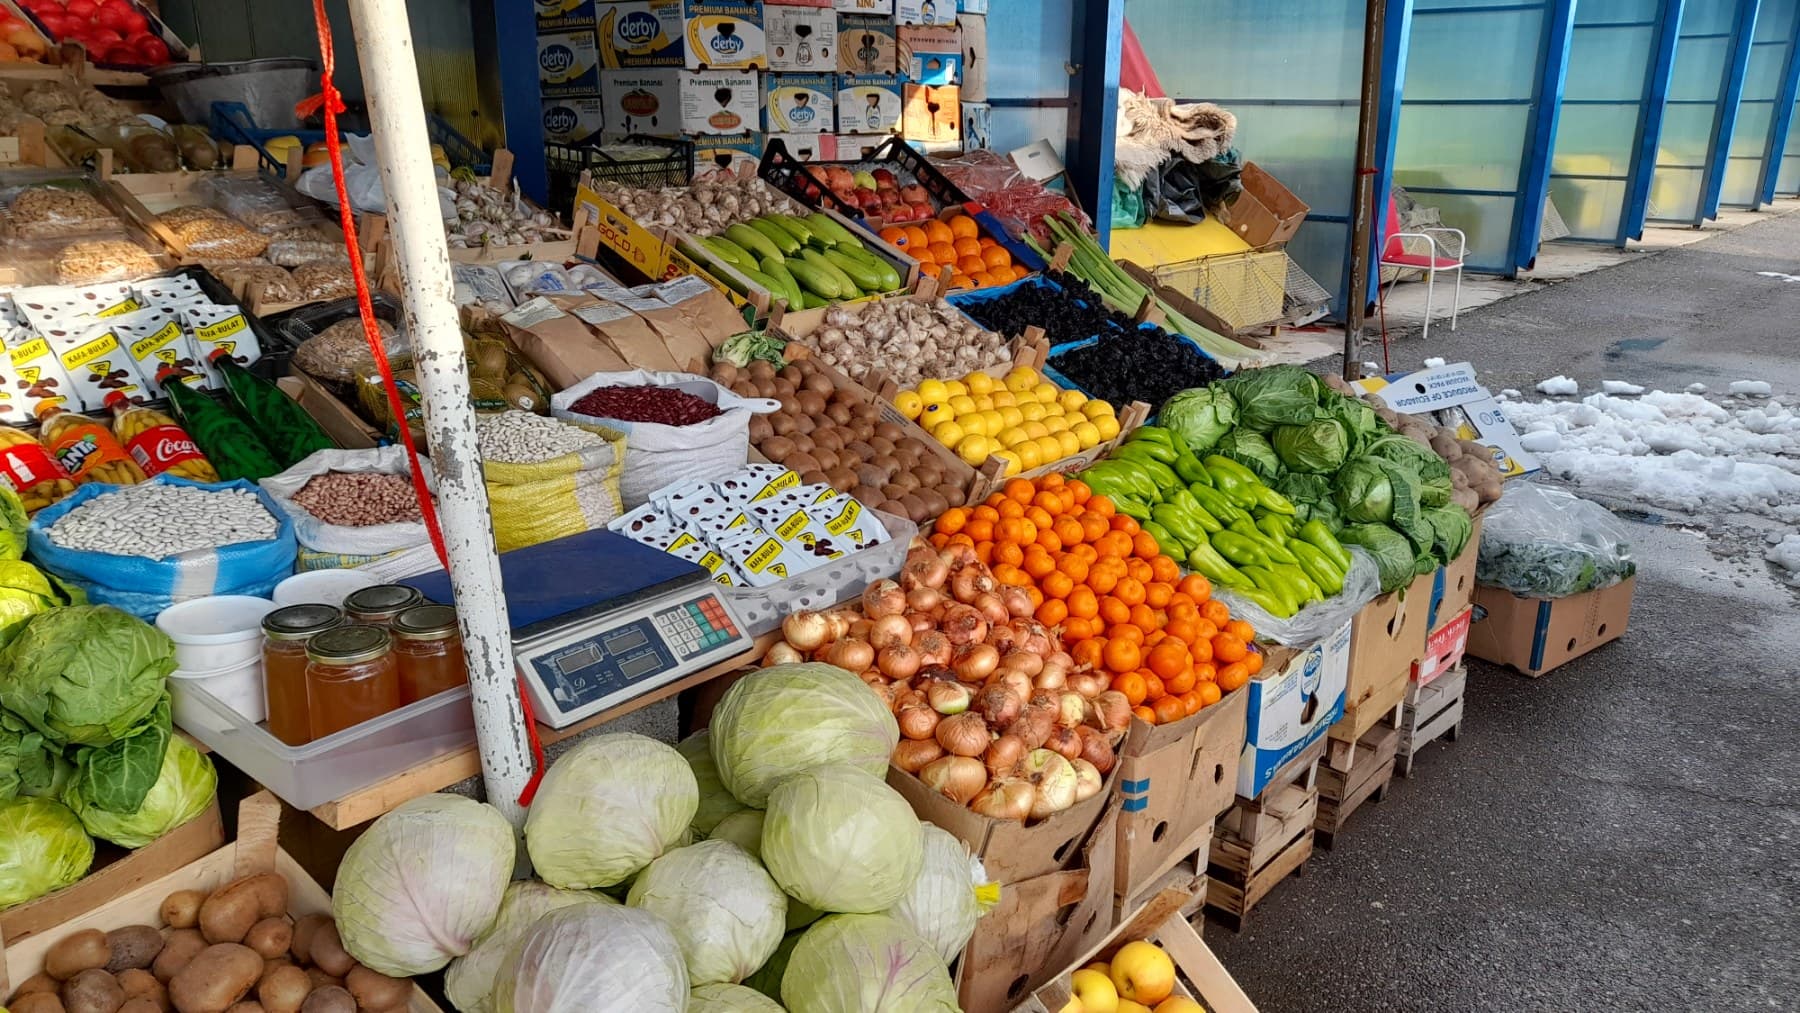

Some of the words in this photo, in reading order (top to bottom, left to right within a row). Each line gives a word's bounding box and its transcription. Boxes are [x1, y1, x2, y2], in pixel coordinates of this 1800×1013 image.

[688, 5, 723, 15] PREMIUM
[724, 6, 758, 16] BANANAS
[564, 16, 595, 26] BANANAS
[620, 16, 657, 42] derby
[713, 36, 743, 52] derby
[541, 48, 573, 69] derby
[653, 56, 684, 65] BANANAS
[613, 79, 638, 87] Premium
[640, 79, 663, 87] Bananas
[689, 79, 724, 88] Premium
[725, 78, 752, 87] Bananas
[545, 109, 576, 132] derby
[790, 107, 815, 121] derby
[597, 222, 631, 252] GOLD
[67, 338, 111, 365] KAFA-BULAT
[1431, 392, 1442, 401] OF
[1443, 386, 1478, 398] PRODUCE
[1395, 395, 1430, 408] ECUADOR
[750, 543, 777, 569] KAFA-BULAT
